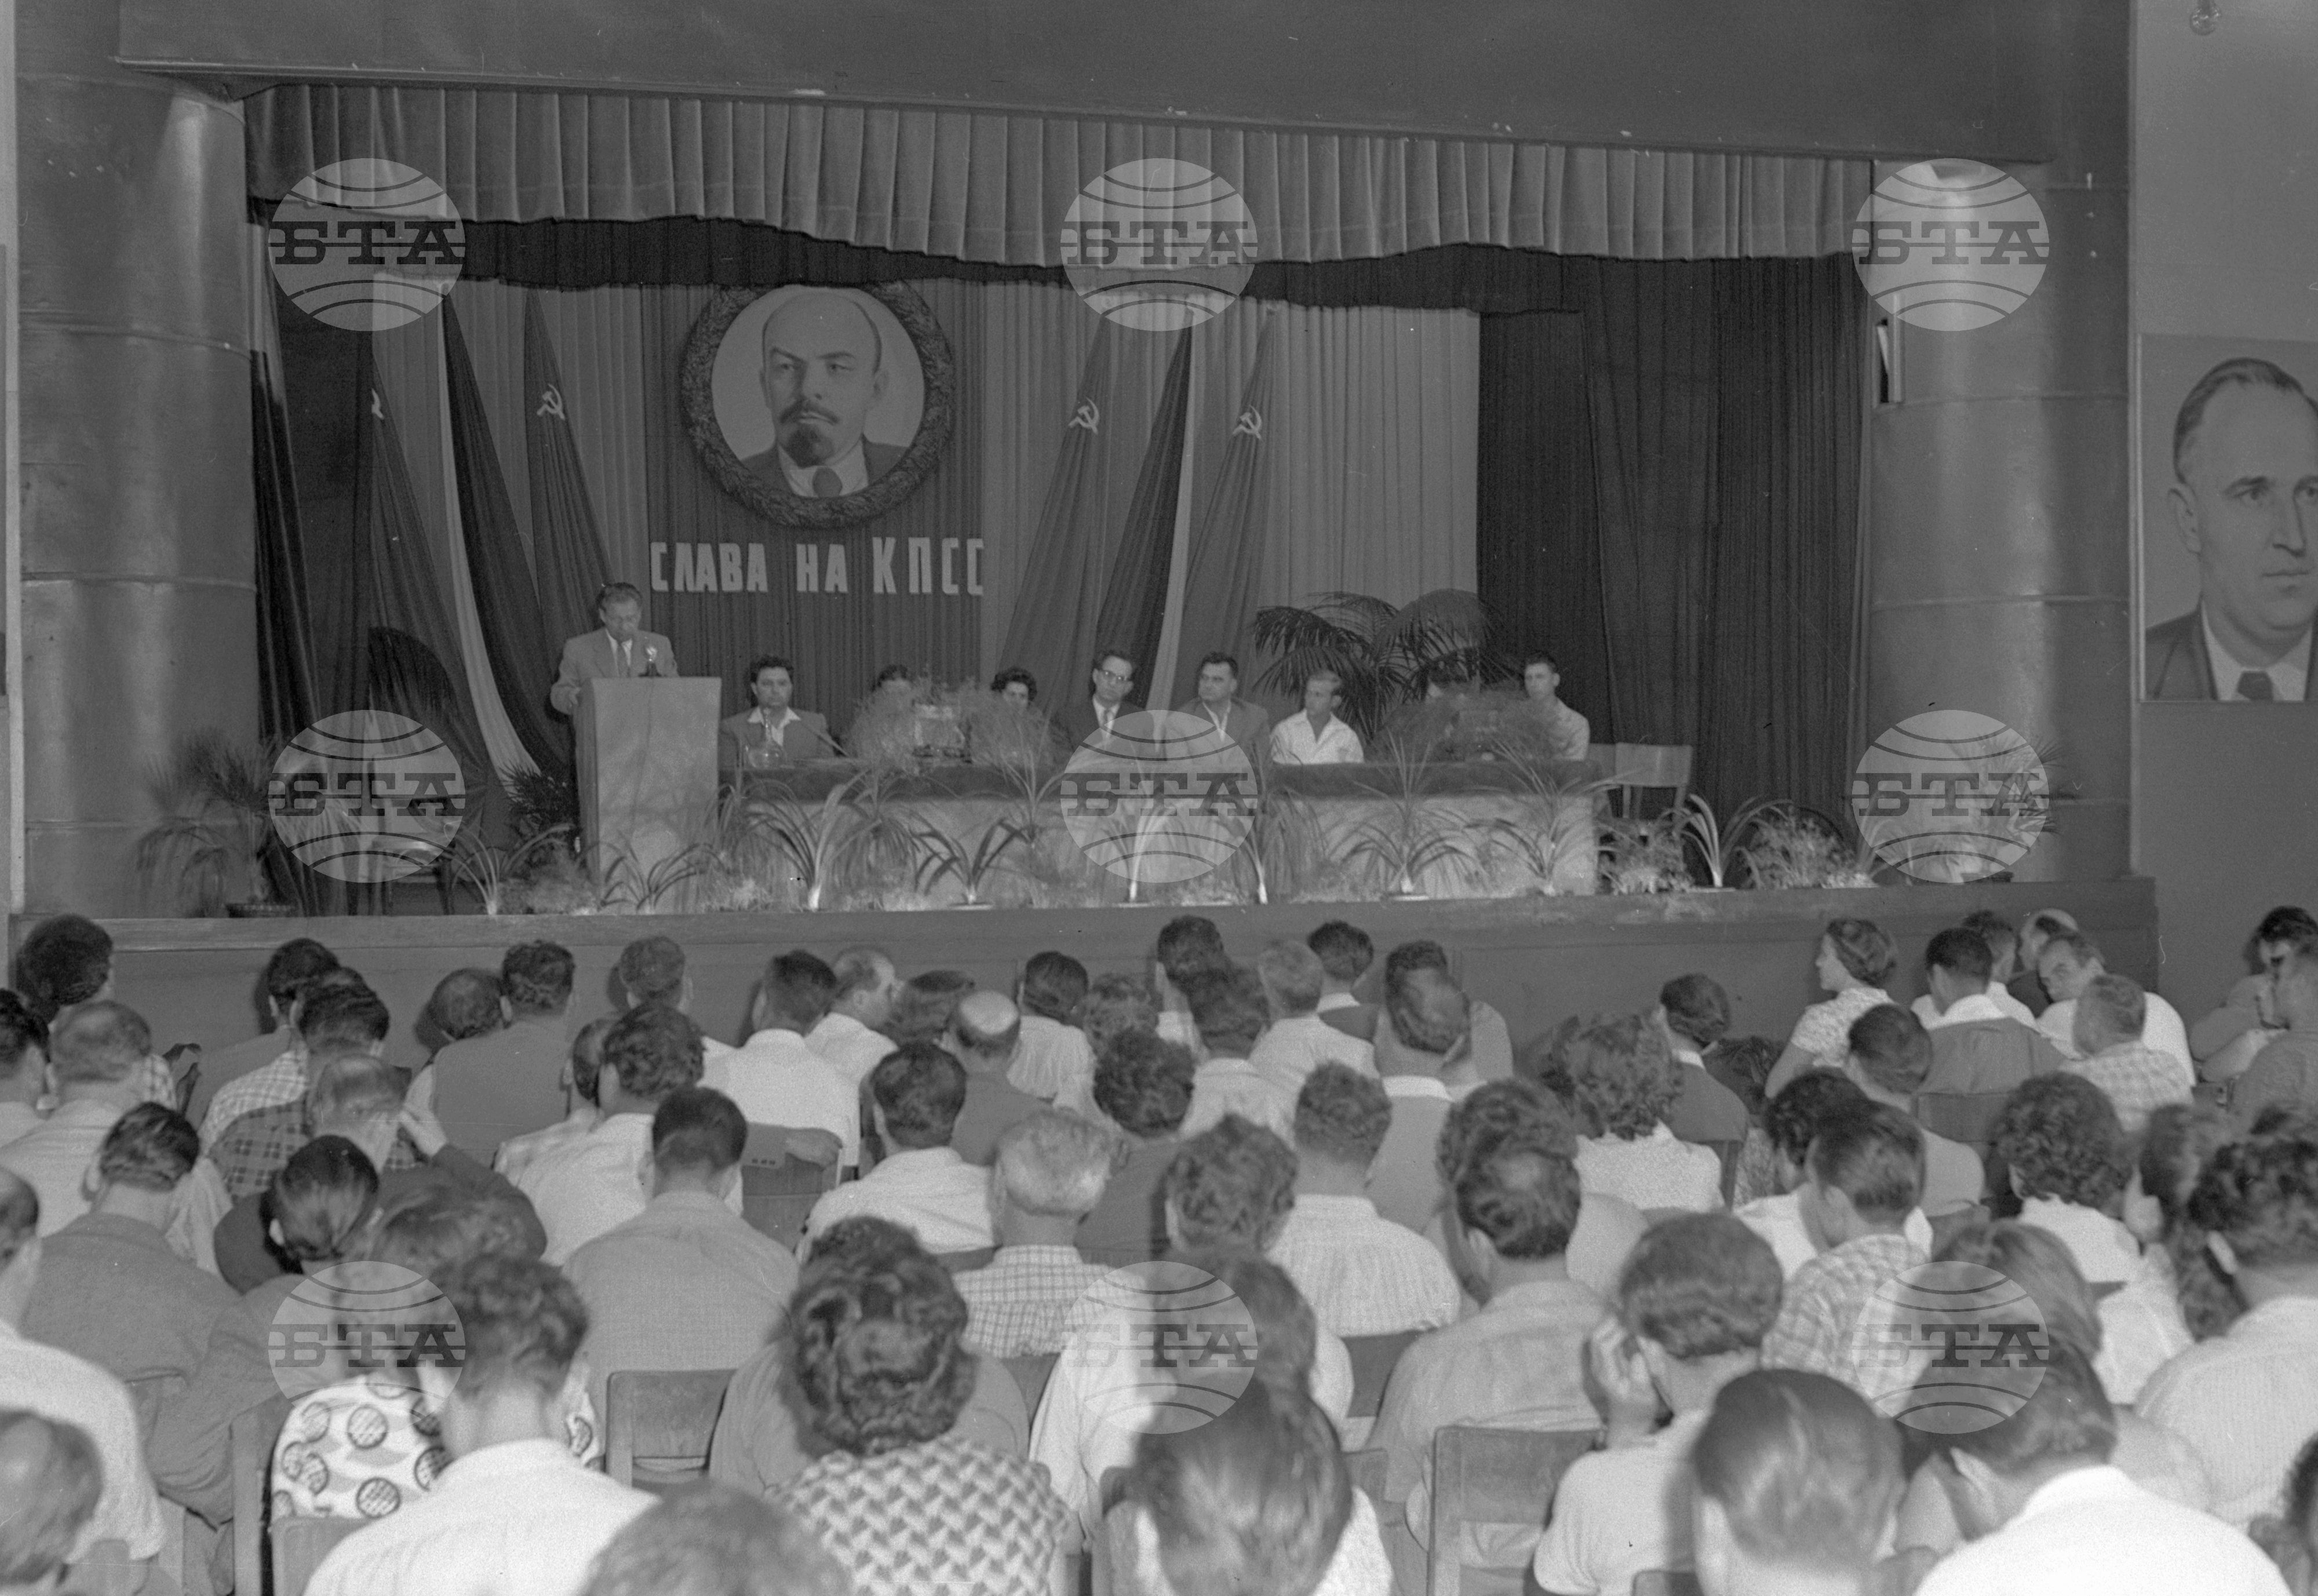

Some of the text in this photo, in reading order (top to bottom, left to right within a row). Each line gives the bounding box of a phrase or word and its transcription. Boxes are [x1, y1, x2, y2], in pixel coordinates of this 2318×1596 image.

[650, 537, 984, 596] СЛАВА НА КПСС
